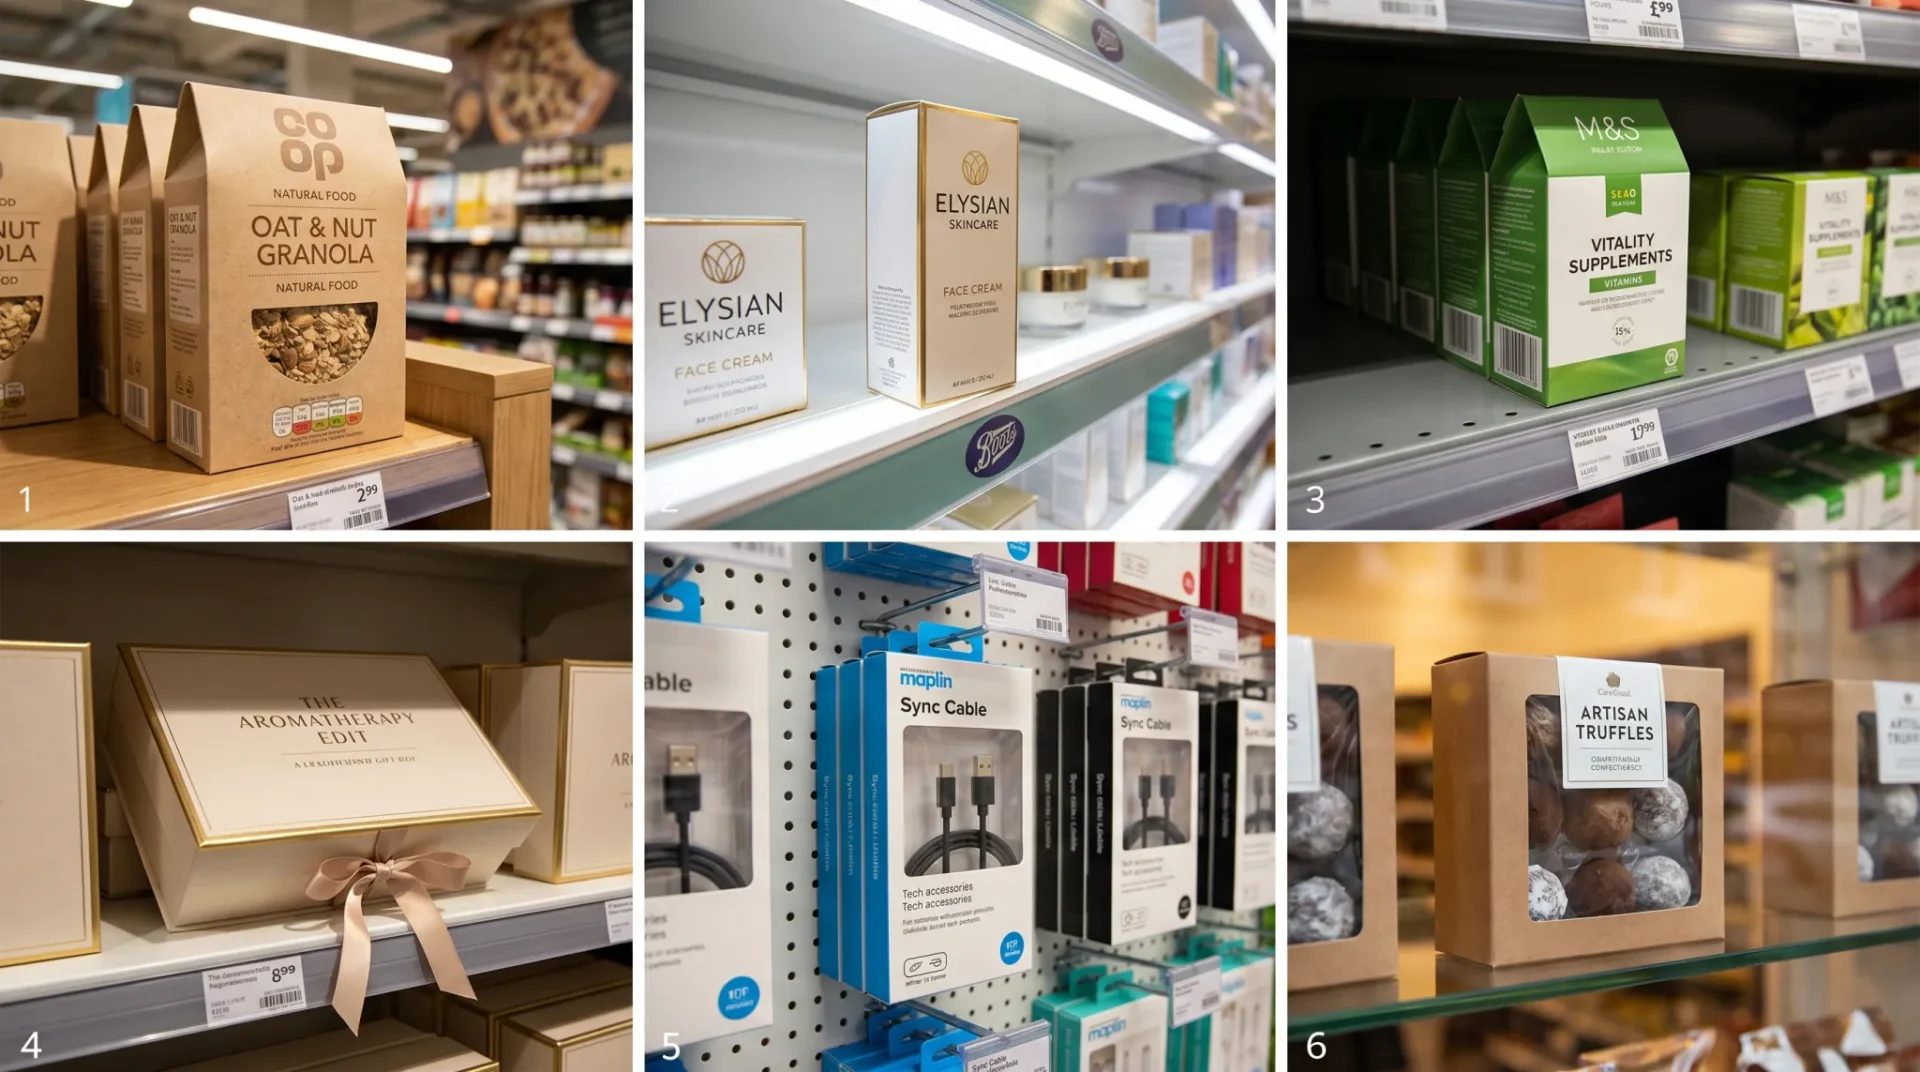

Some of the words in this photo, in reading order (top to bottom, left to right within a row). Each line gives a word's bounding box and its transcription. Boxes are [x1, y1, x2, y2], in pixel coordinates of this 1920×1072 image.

[1574, 116, 1640, 141] M&S
[273, 188, 324, 201] NATURAL
[326, 190, 357, 202] FOOD
[936, 193, 1010, 215] ELYSIAN
[250, 215, 302, 238] OAT
[308, 216, 326, 237] &
[332, 217, 377, 238] NUT
[949, 219, 999, 230] SKINCARE
[1591, 233, 1655, 252] VITALITY
[256, 242, 374, 266] GRANOLA
[1569, 249, 1673, 274] SUPPLEMENTS
[276, 281, 327, 294] NATURAL
[328, 279, 358, 292] FOOD
[943, 285, 969, 297] FACE
[971, 283, 1003, 294] CREAM
[1604, 275, 1643, 288] VITAMINS
[659, 291, 783, 327] ELYSIAN
[684, 323, 766, 346] SKINCARE
[674, 361, 717, 380] FACE
[722, 351, 774, 371] CREAM
[974, 421, 1017, 473] Boots
[900, 671, 953, 690] maplin
[299, 697, 346, 709] THE
[900, 697, 940, 717] Sync
[945, 699, 987, 717] Cable
[240, 712, 415, 729] AROMATHERAPY
[1581, 705, 1648, 721] ARTISAN
[1120, 716, 1144, 731] Sync
[1146, 718, 1172, 731] Cable
[1576, 724, 1654, 740] TRUFFLES
[317, 730, 368, 745] EDIT
[902, 888, 923, 899] Tech
[925, 882, 973, 897] accessories
[902, 900, 923, 912] Tech
[925, 894, 972, 909] accessories
